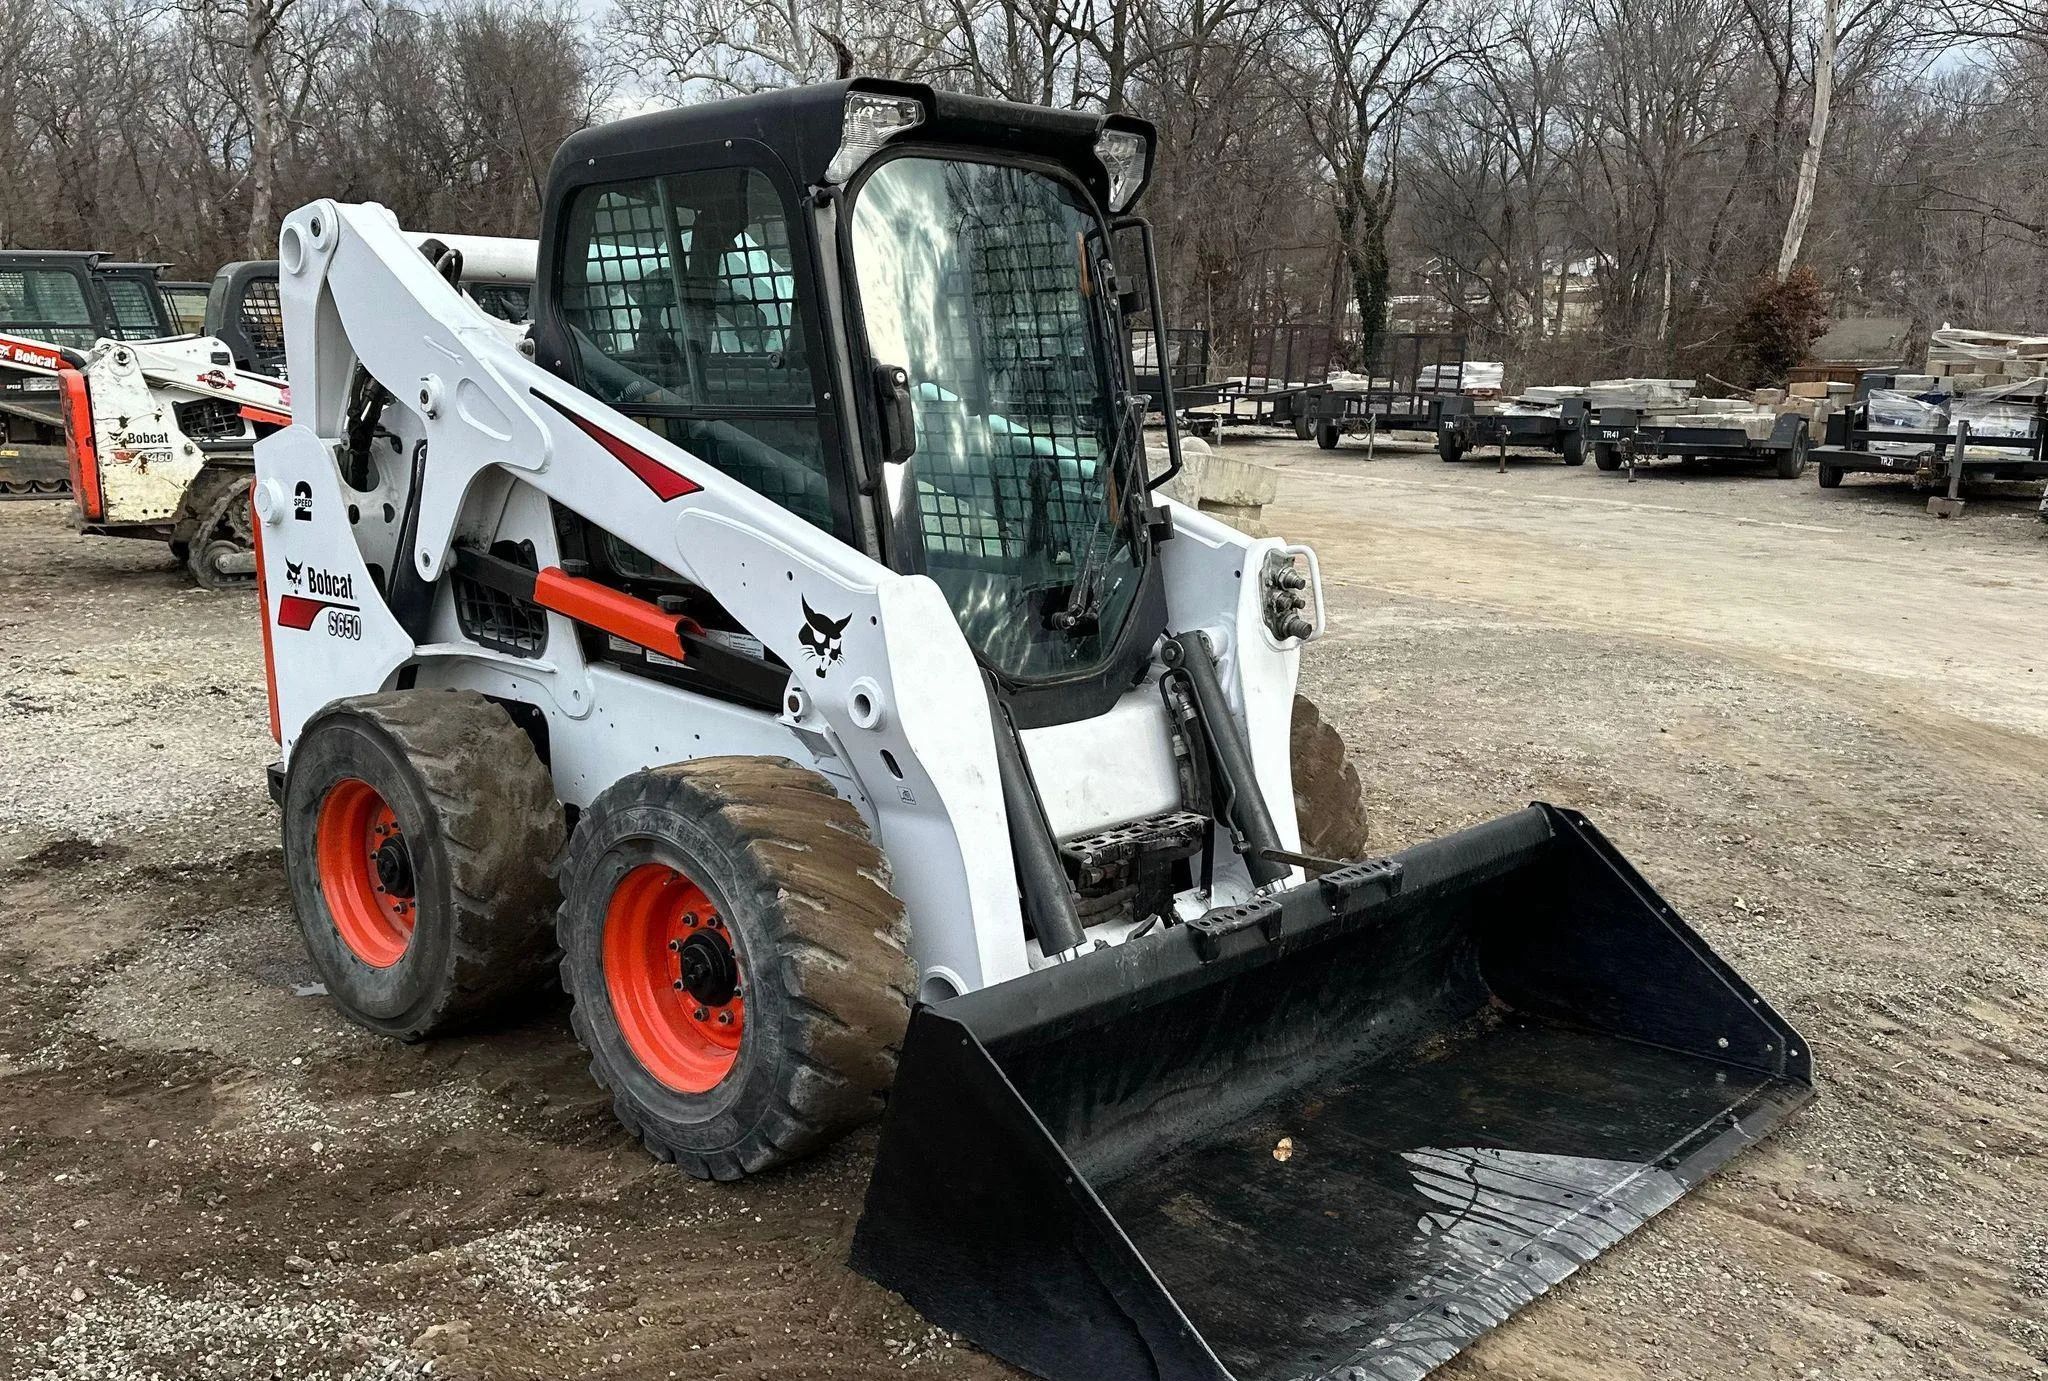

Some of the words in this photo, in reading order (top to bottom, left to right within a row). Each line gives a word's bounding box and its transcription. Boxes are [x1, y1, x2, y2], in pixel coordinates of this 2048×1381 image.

[14, 348, 57, 369] Bobcat
[127, 432, 169, 444] Bobcat
[1602, 430, 1619, 439] TR41
[293, 498, 313, 508] SPEED
[307, 566, 354, 600] Bobcat
[327, 610, 362, 641] S650
